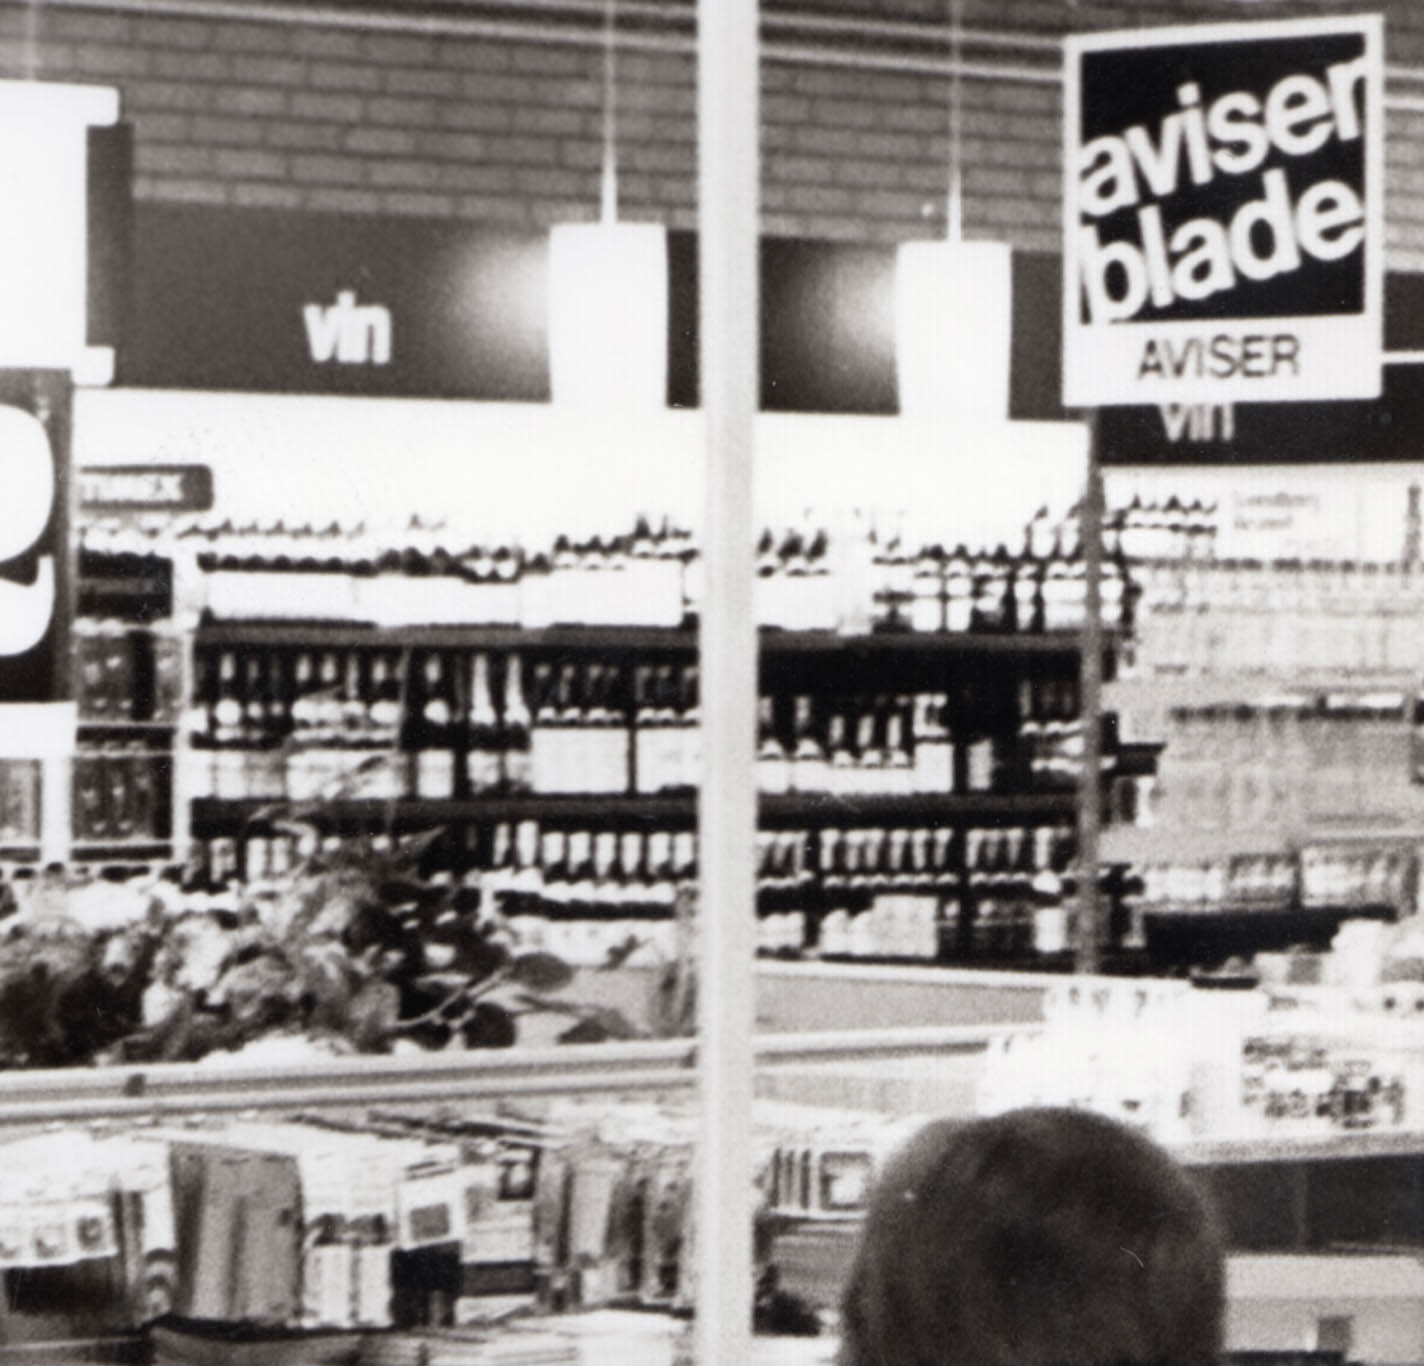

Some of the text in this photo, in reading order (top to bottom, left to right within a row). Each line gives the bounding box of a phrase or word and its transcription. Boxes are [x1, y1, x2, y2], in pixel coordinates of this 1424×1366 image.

[1078, 54, 1366, 218] aviser
[1078, 167, 1365, 325] blade
[303, 289, 391, 363] vin
[1136, 334, 1301, 381] AVISER
